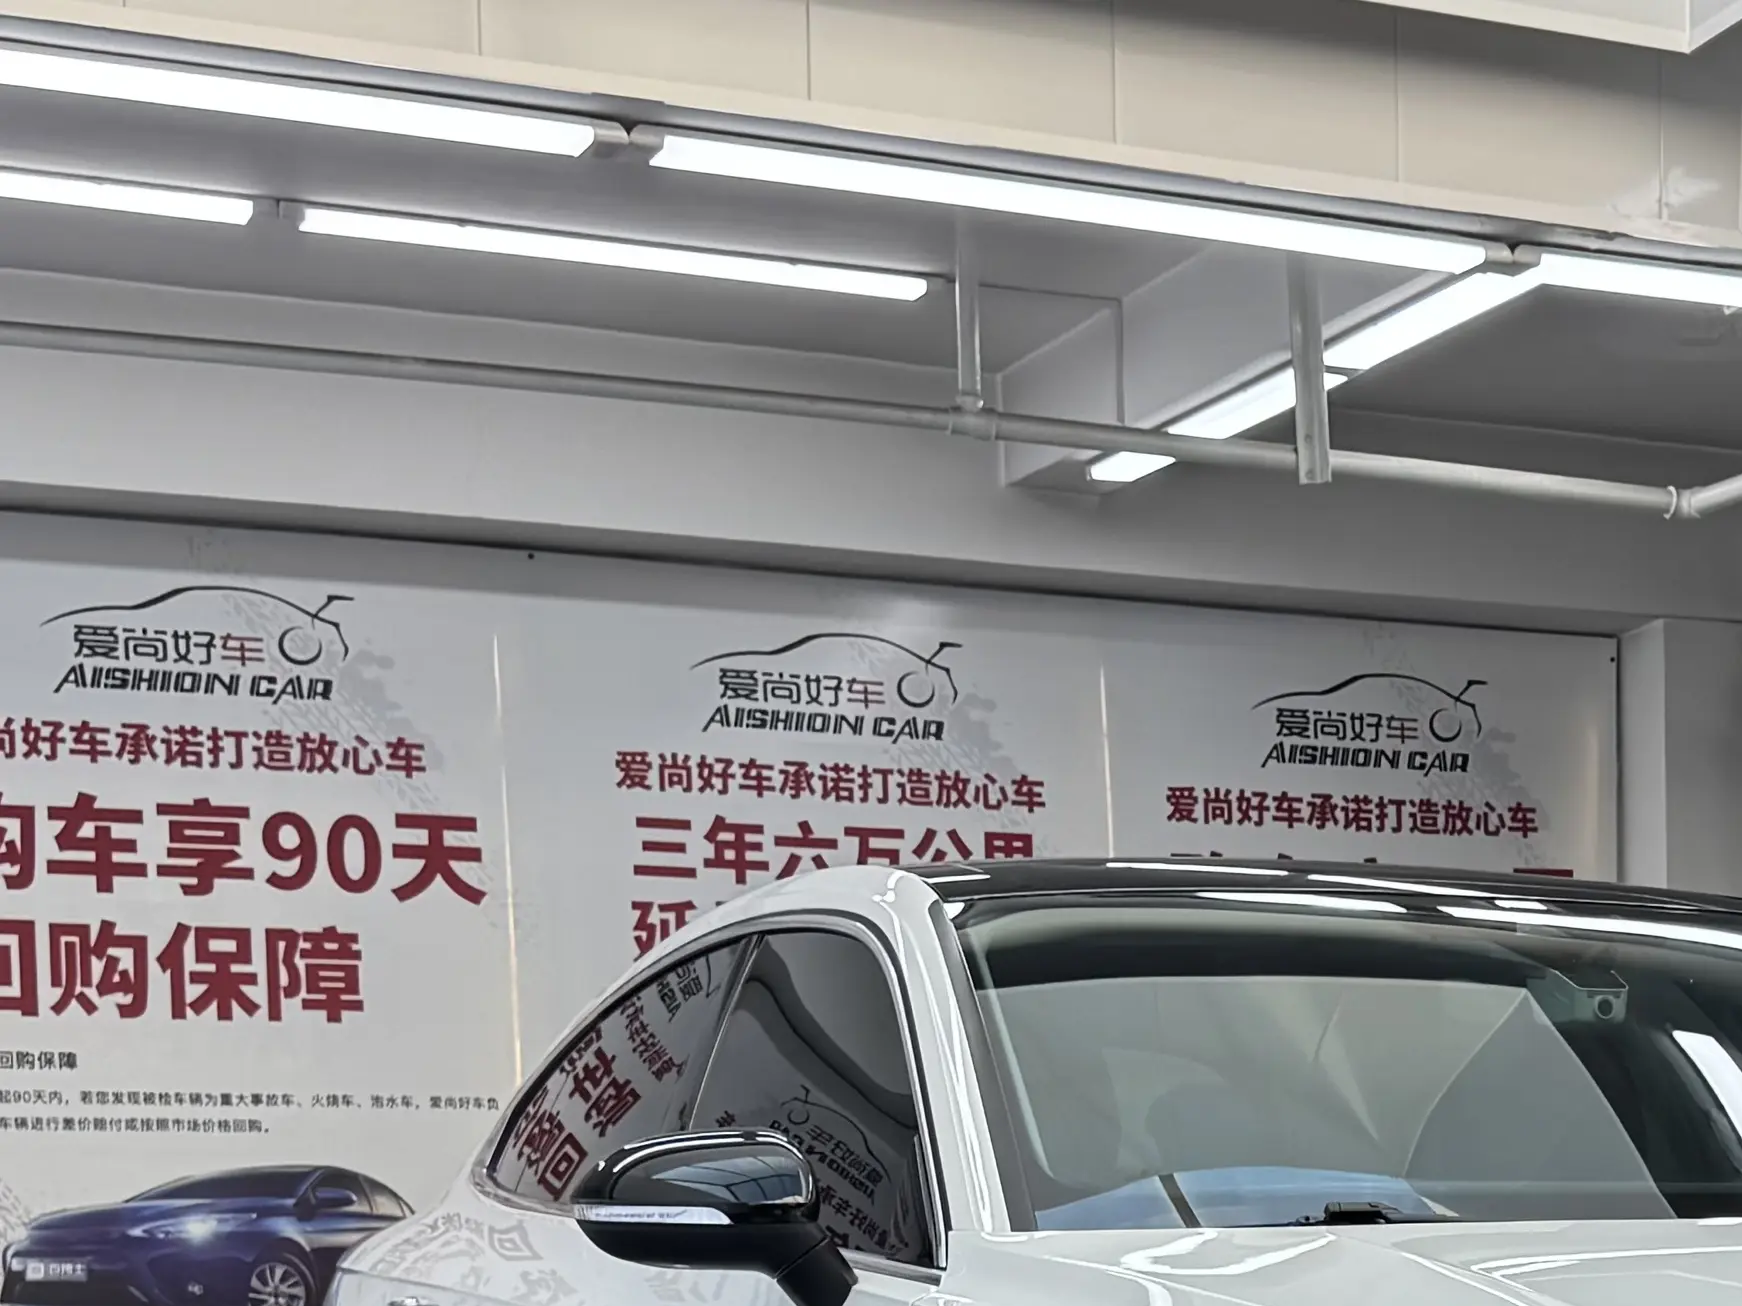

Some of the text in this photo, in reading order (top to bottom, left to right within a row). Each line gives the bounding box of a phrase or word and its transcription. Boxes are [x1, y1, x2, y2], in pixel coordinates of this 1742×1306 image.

[73, 624, 265, 667] 爱尚好车
[249, 674, 334, 704] CAR
[716, 667, 886, 709] 爱尚好车
[872, 716, 945, 744] CAR
[1275, 707, 1420, 744] 爱尚好车
[614, 750, 1047, 814] 爱尚好车承诺打造放心车
[1407, 748, 1471, 777] CAR
[1165, 785, 1540, 840] 爱尚好车承诺打造放心车
